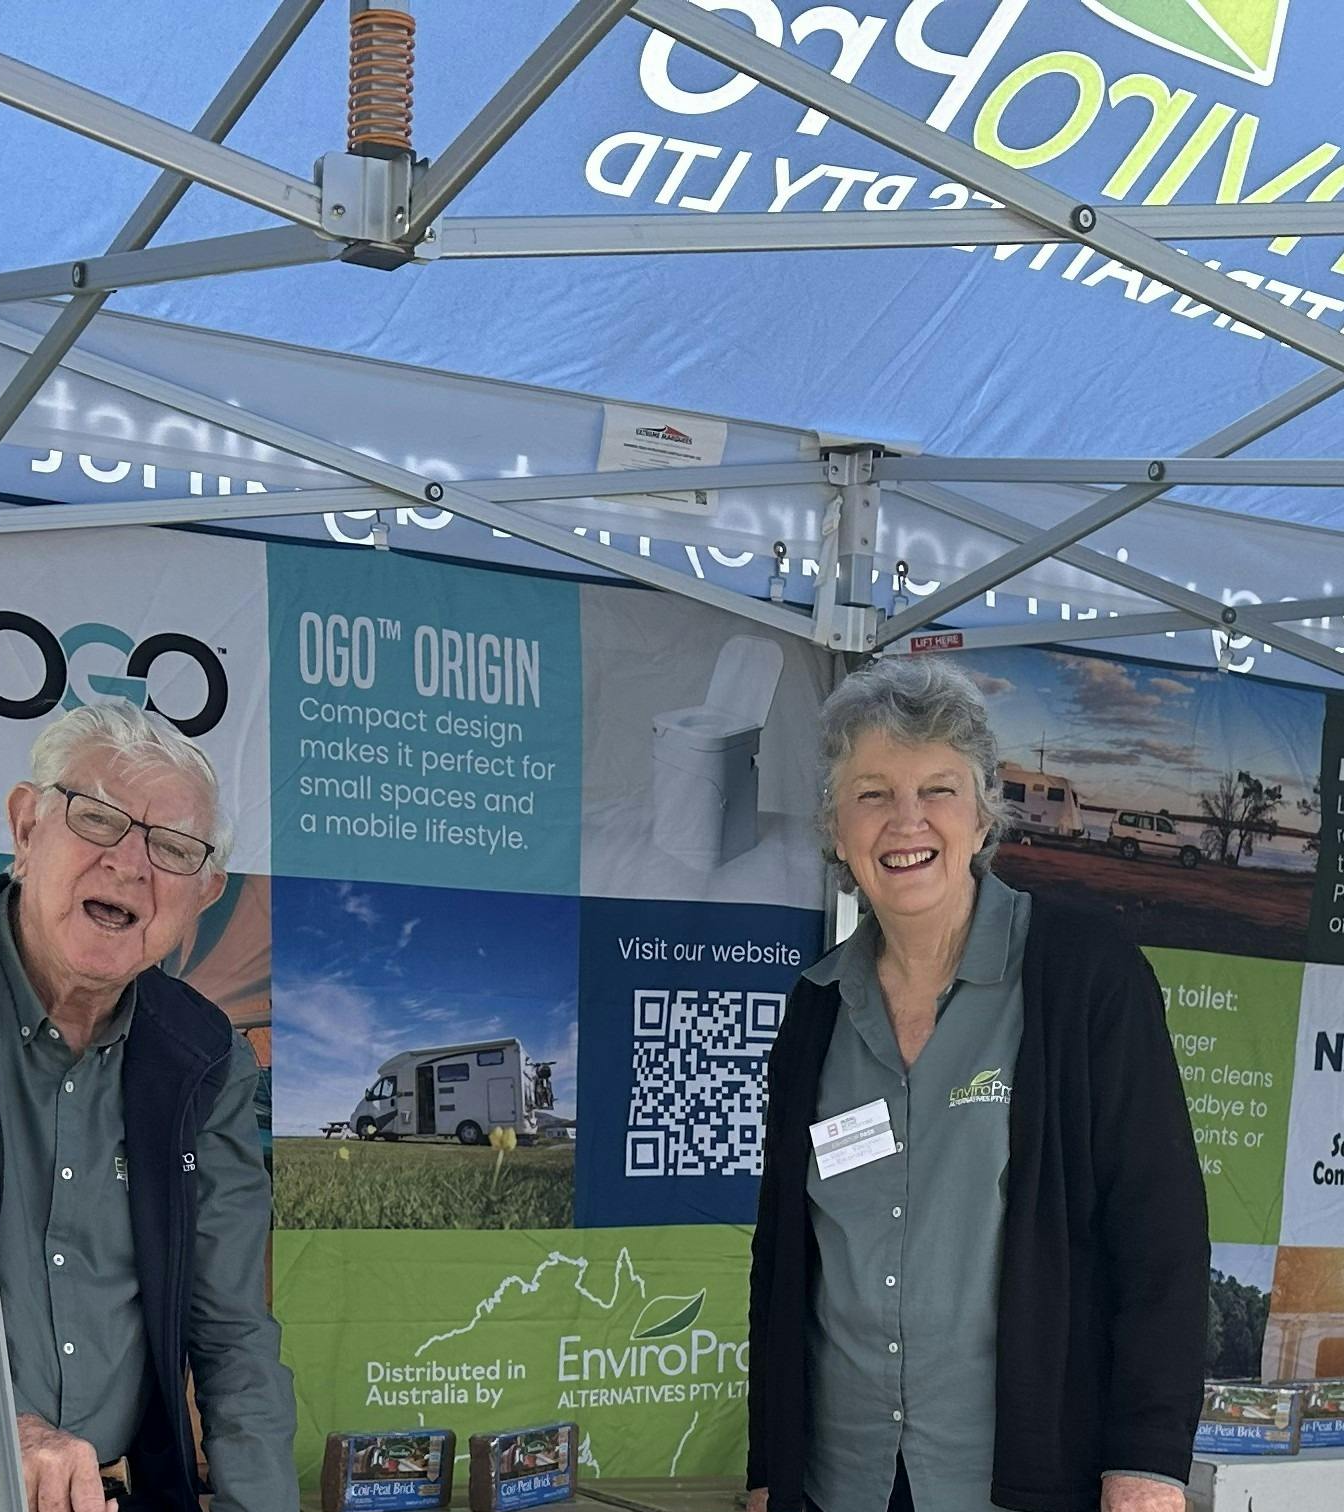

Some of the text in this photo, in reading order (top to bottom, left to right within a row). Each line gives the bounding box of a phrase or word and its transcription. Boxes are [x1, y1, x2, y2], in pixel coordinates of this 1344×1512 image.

[415, 625, 540, 708] ORIGIN
[300, 698, 522, 747] Compact design
[301, 737, 555, 780] makes it perfect for
[300, 776, 533, 814] small spaces and
[301, 813, 528, 854] a mobile lifestyle.
[619, 937, 800, 965] Visit our website
[368, 1359, 527, 1382] Distributed in
[366, 1383, 503, 1408] Australia by
[558, 1382, 723, 1409] ALTERNATIVES PTY
[1237, 1426, 1262, 1438] Brick
[351, 1482, 415, 1498] Coir-Peat Brick
